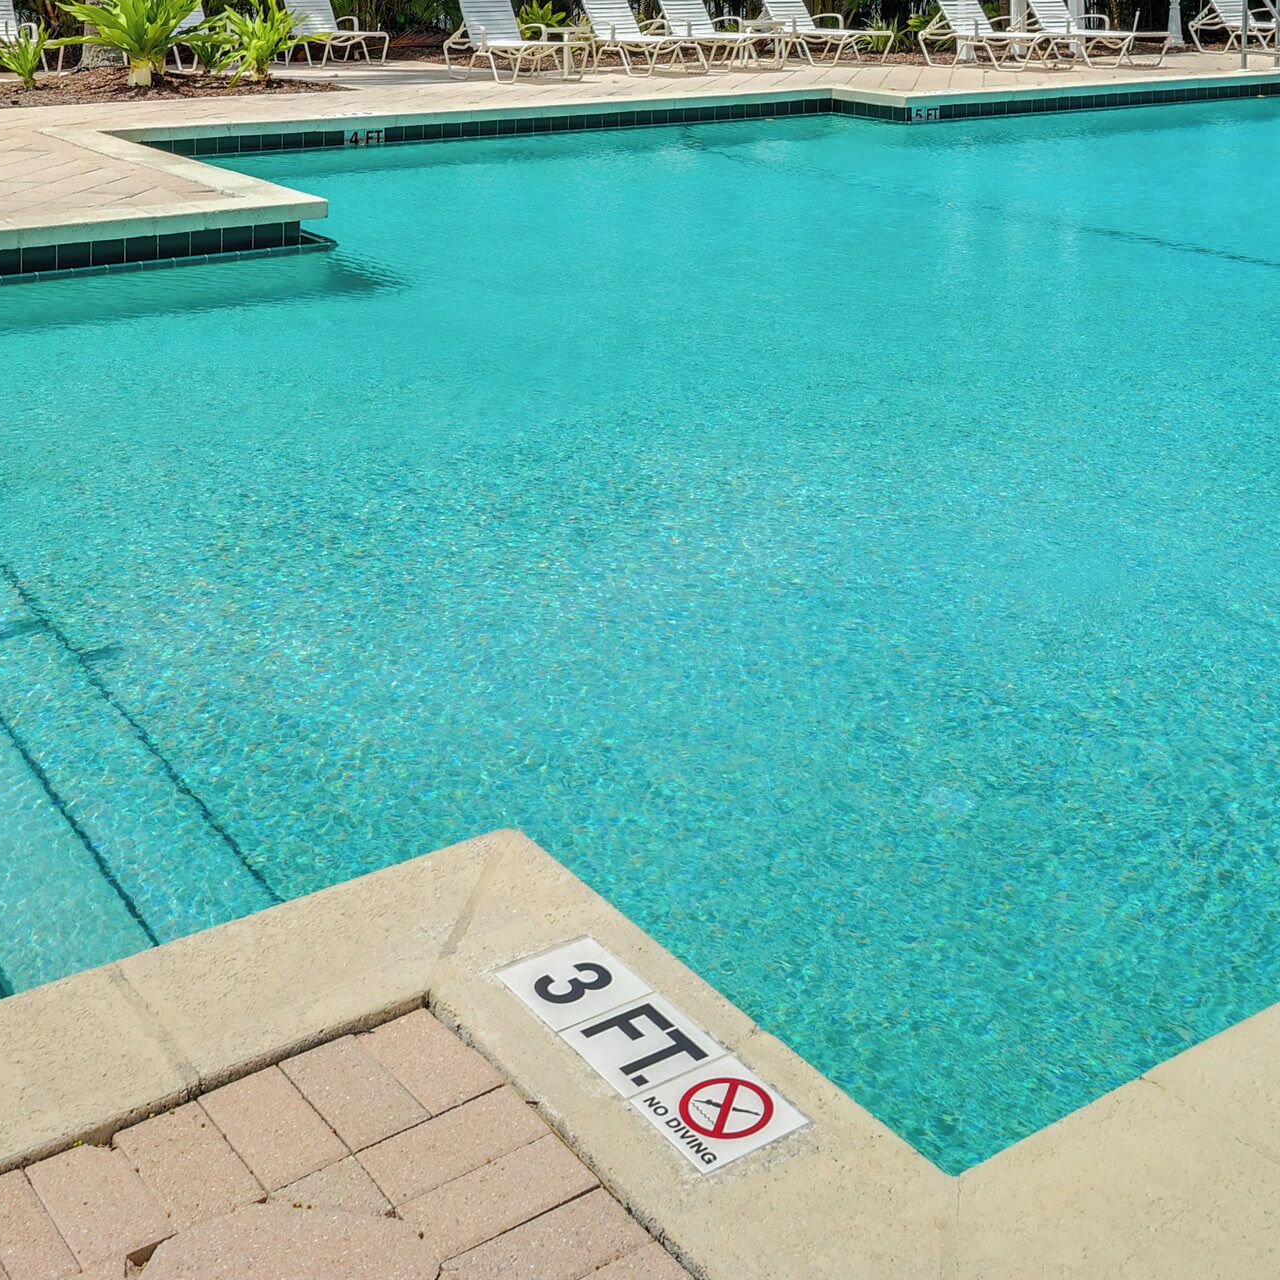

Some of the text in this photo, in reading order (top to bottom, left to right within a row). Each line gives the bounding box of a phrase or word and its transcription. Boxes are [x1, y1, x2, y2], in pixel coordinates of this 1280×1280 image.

[926, 108, 939, 120] FT
[349, 130, 383, 145] 4 FT
[533, 962, 709, 1087] 3 FT.
[642, 1095, 718, 1166] NO DIVING
